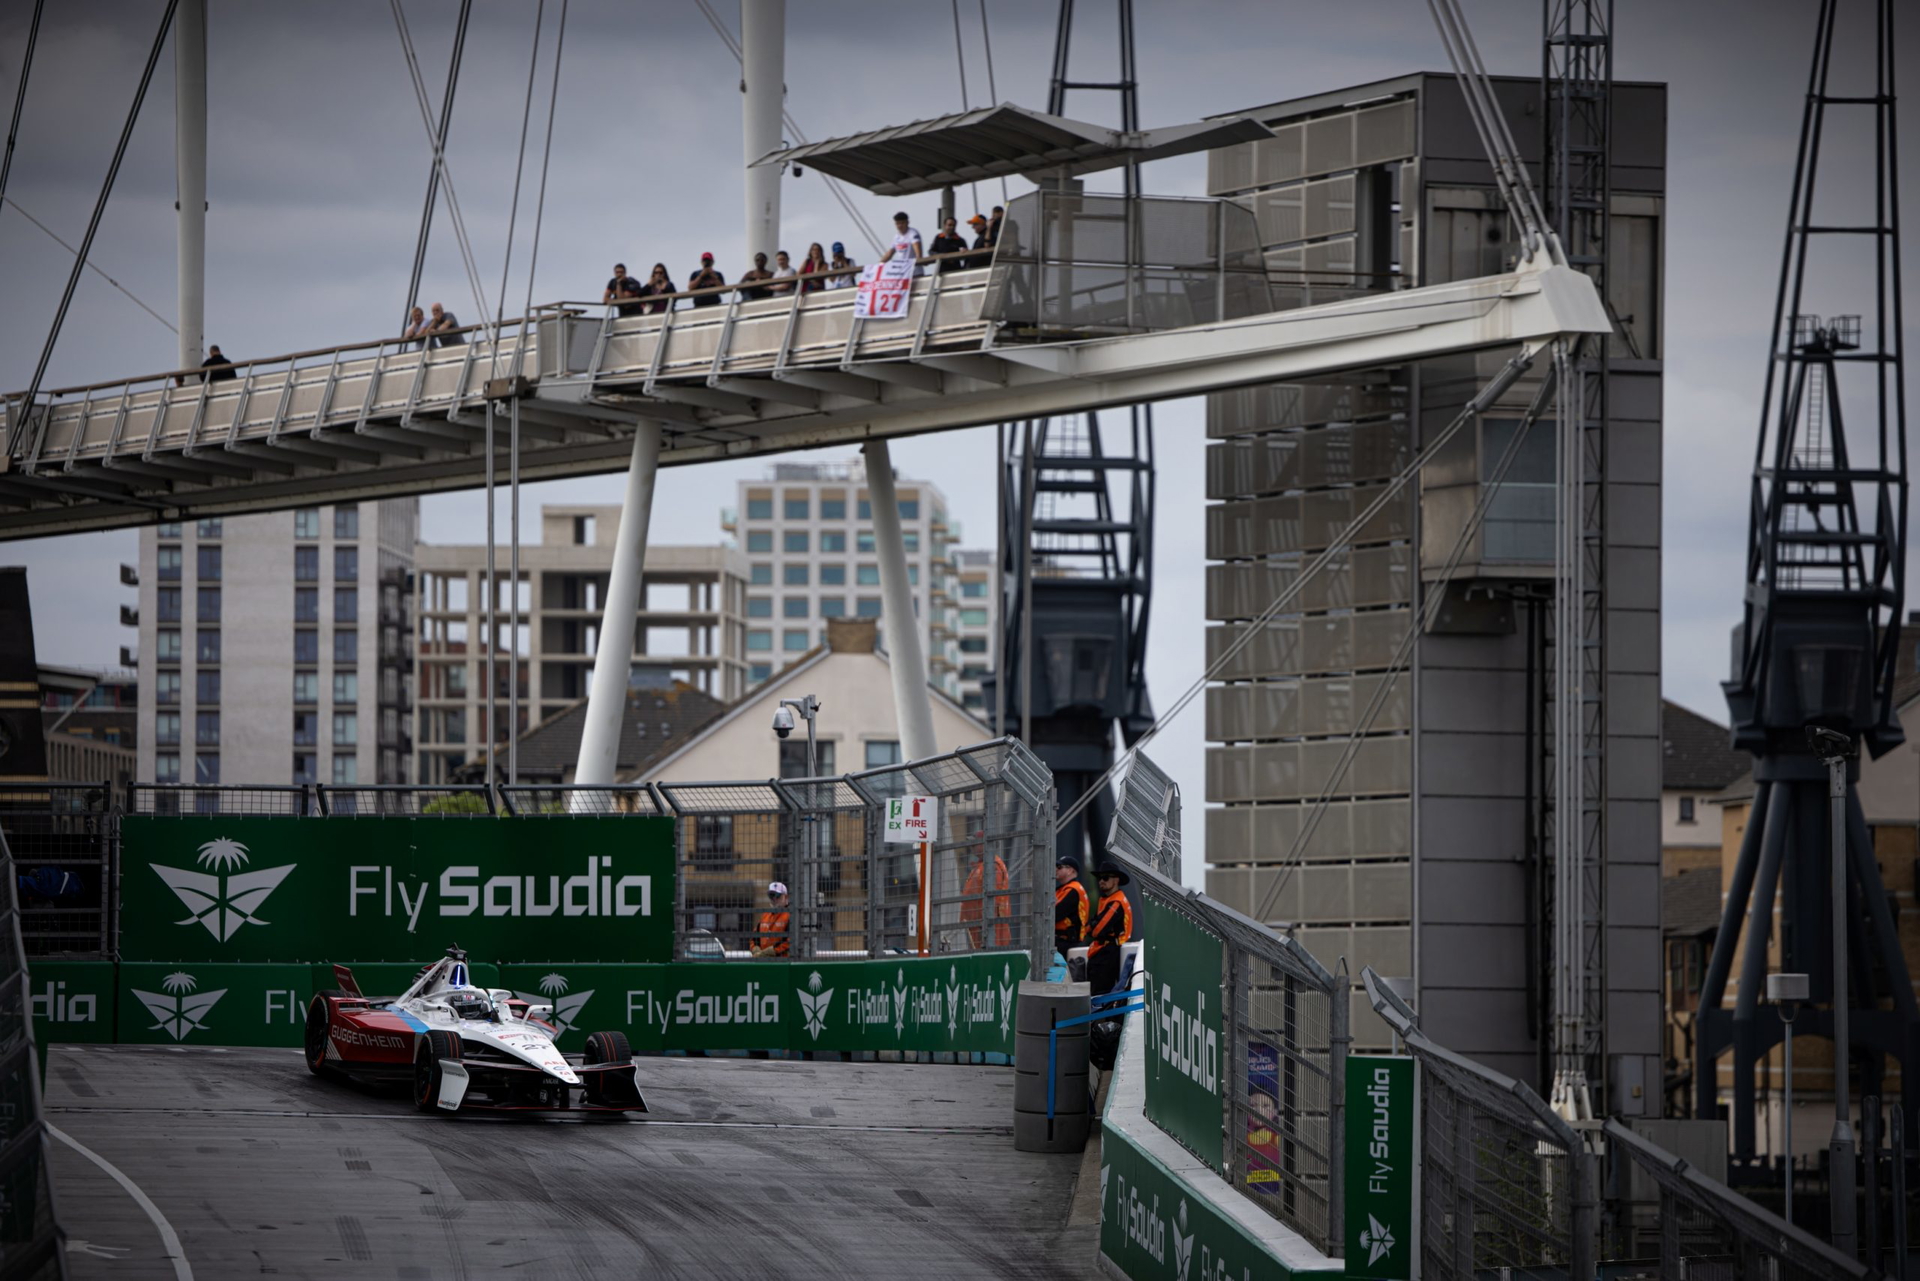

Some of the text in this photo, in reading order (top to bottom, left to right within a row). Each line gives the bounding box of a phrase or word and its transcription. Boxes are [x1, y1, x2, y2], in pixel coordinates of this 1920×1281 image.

[880, 293, 902, 312] 27
[905, 819, 927, 828] FIRE
[349, 855, 652, 932] Fly Saudia
[675, 981, 780, 1024] Saudia
[331, 1024, 406, 1049] GUGGENHEIM
[1366, 1067, 1390, 1159] Saudia
[1201, 1244, 1216, 1281] Fl
